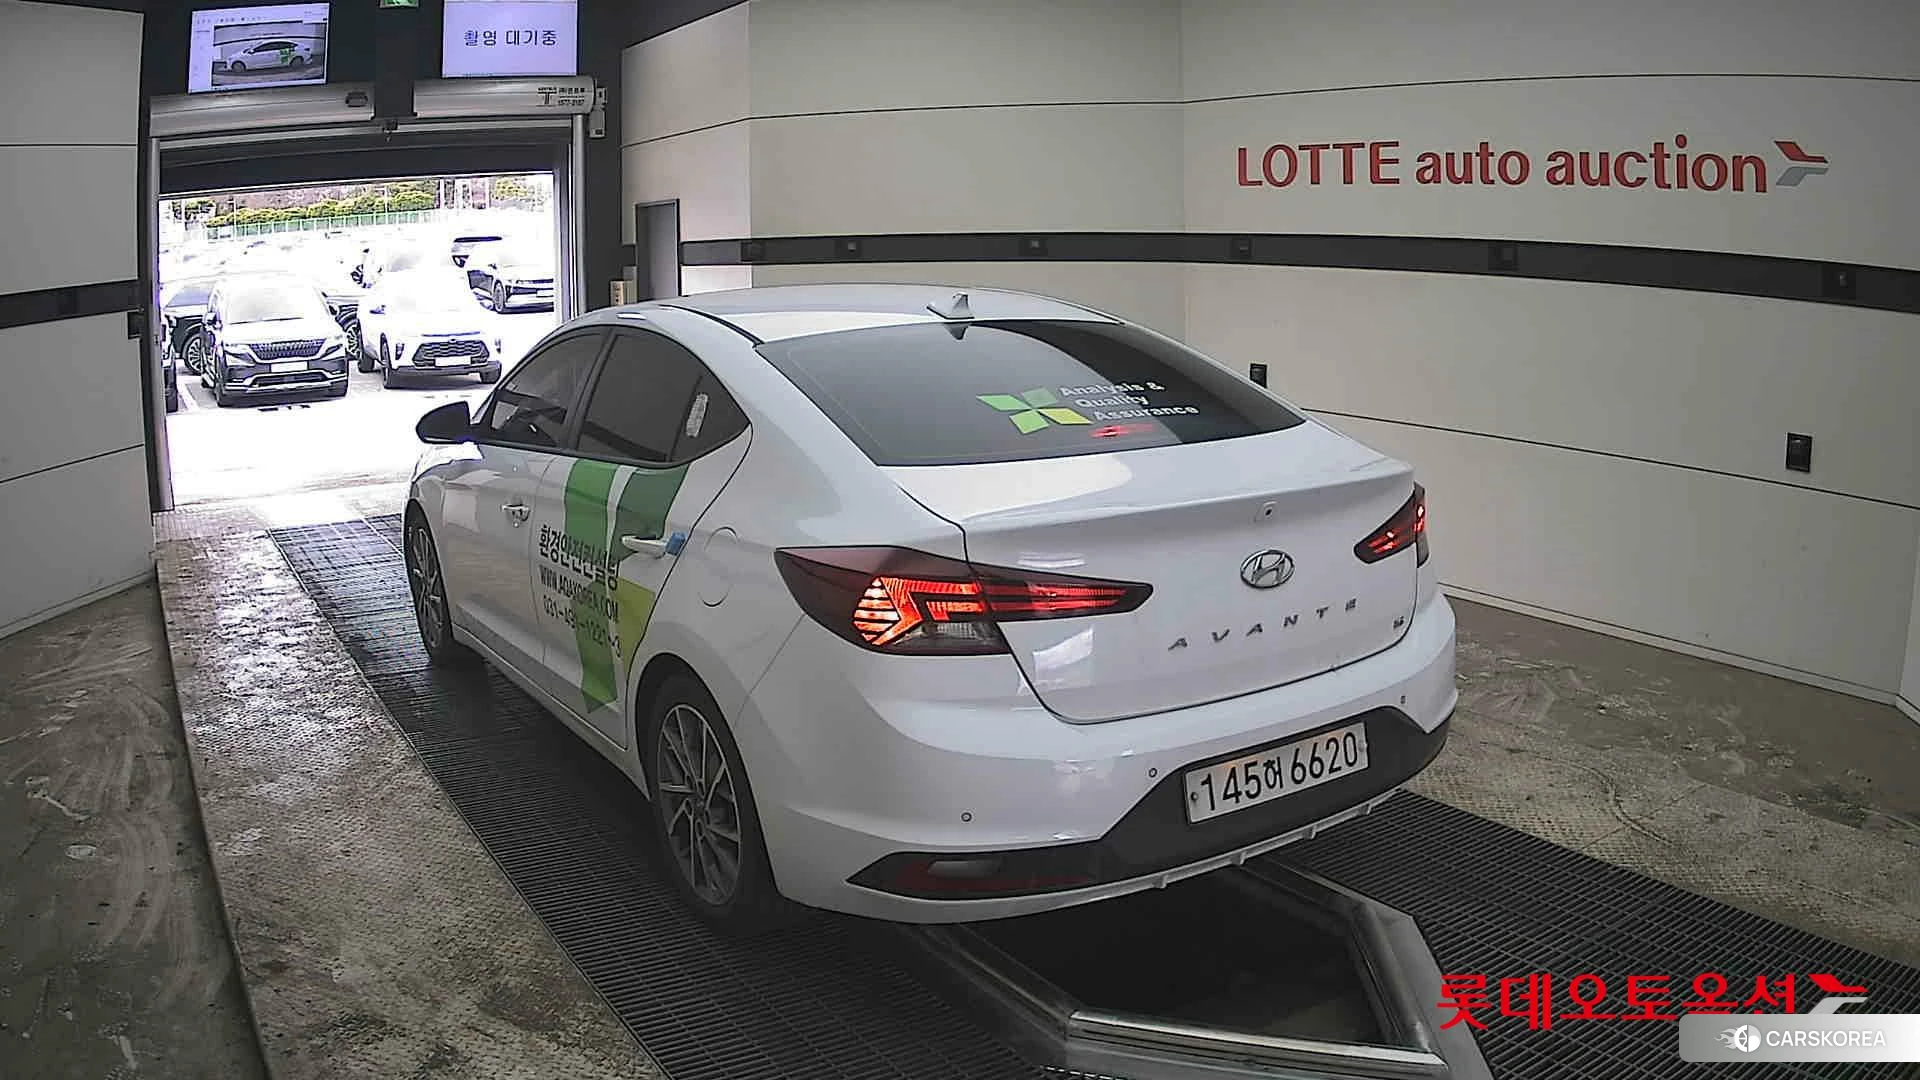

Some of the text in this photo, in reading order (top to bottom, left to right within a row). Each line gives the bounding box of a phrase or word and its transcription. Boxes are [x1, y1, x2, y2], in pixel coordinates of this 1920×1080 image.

[463, 29, 557, 46] 촬영 대기중
[1237, 134, 1768, 193] LOTTE auto auction
[1060, 381, 1165, 397] Analysis &
[1075, 395, 1149, 408] Quality
[1094, 406, 1199, 421] Assurance
[1167, 598, 1357, 651] AVANTE
